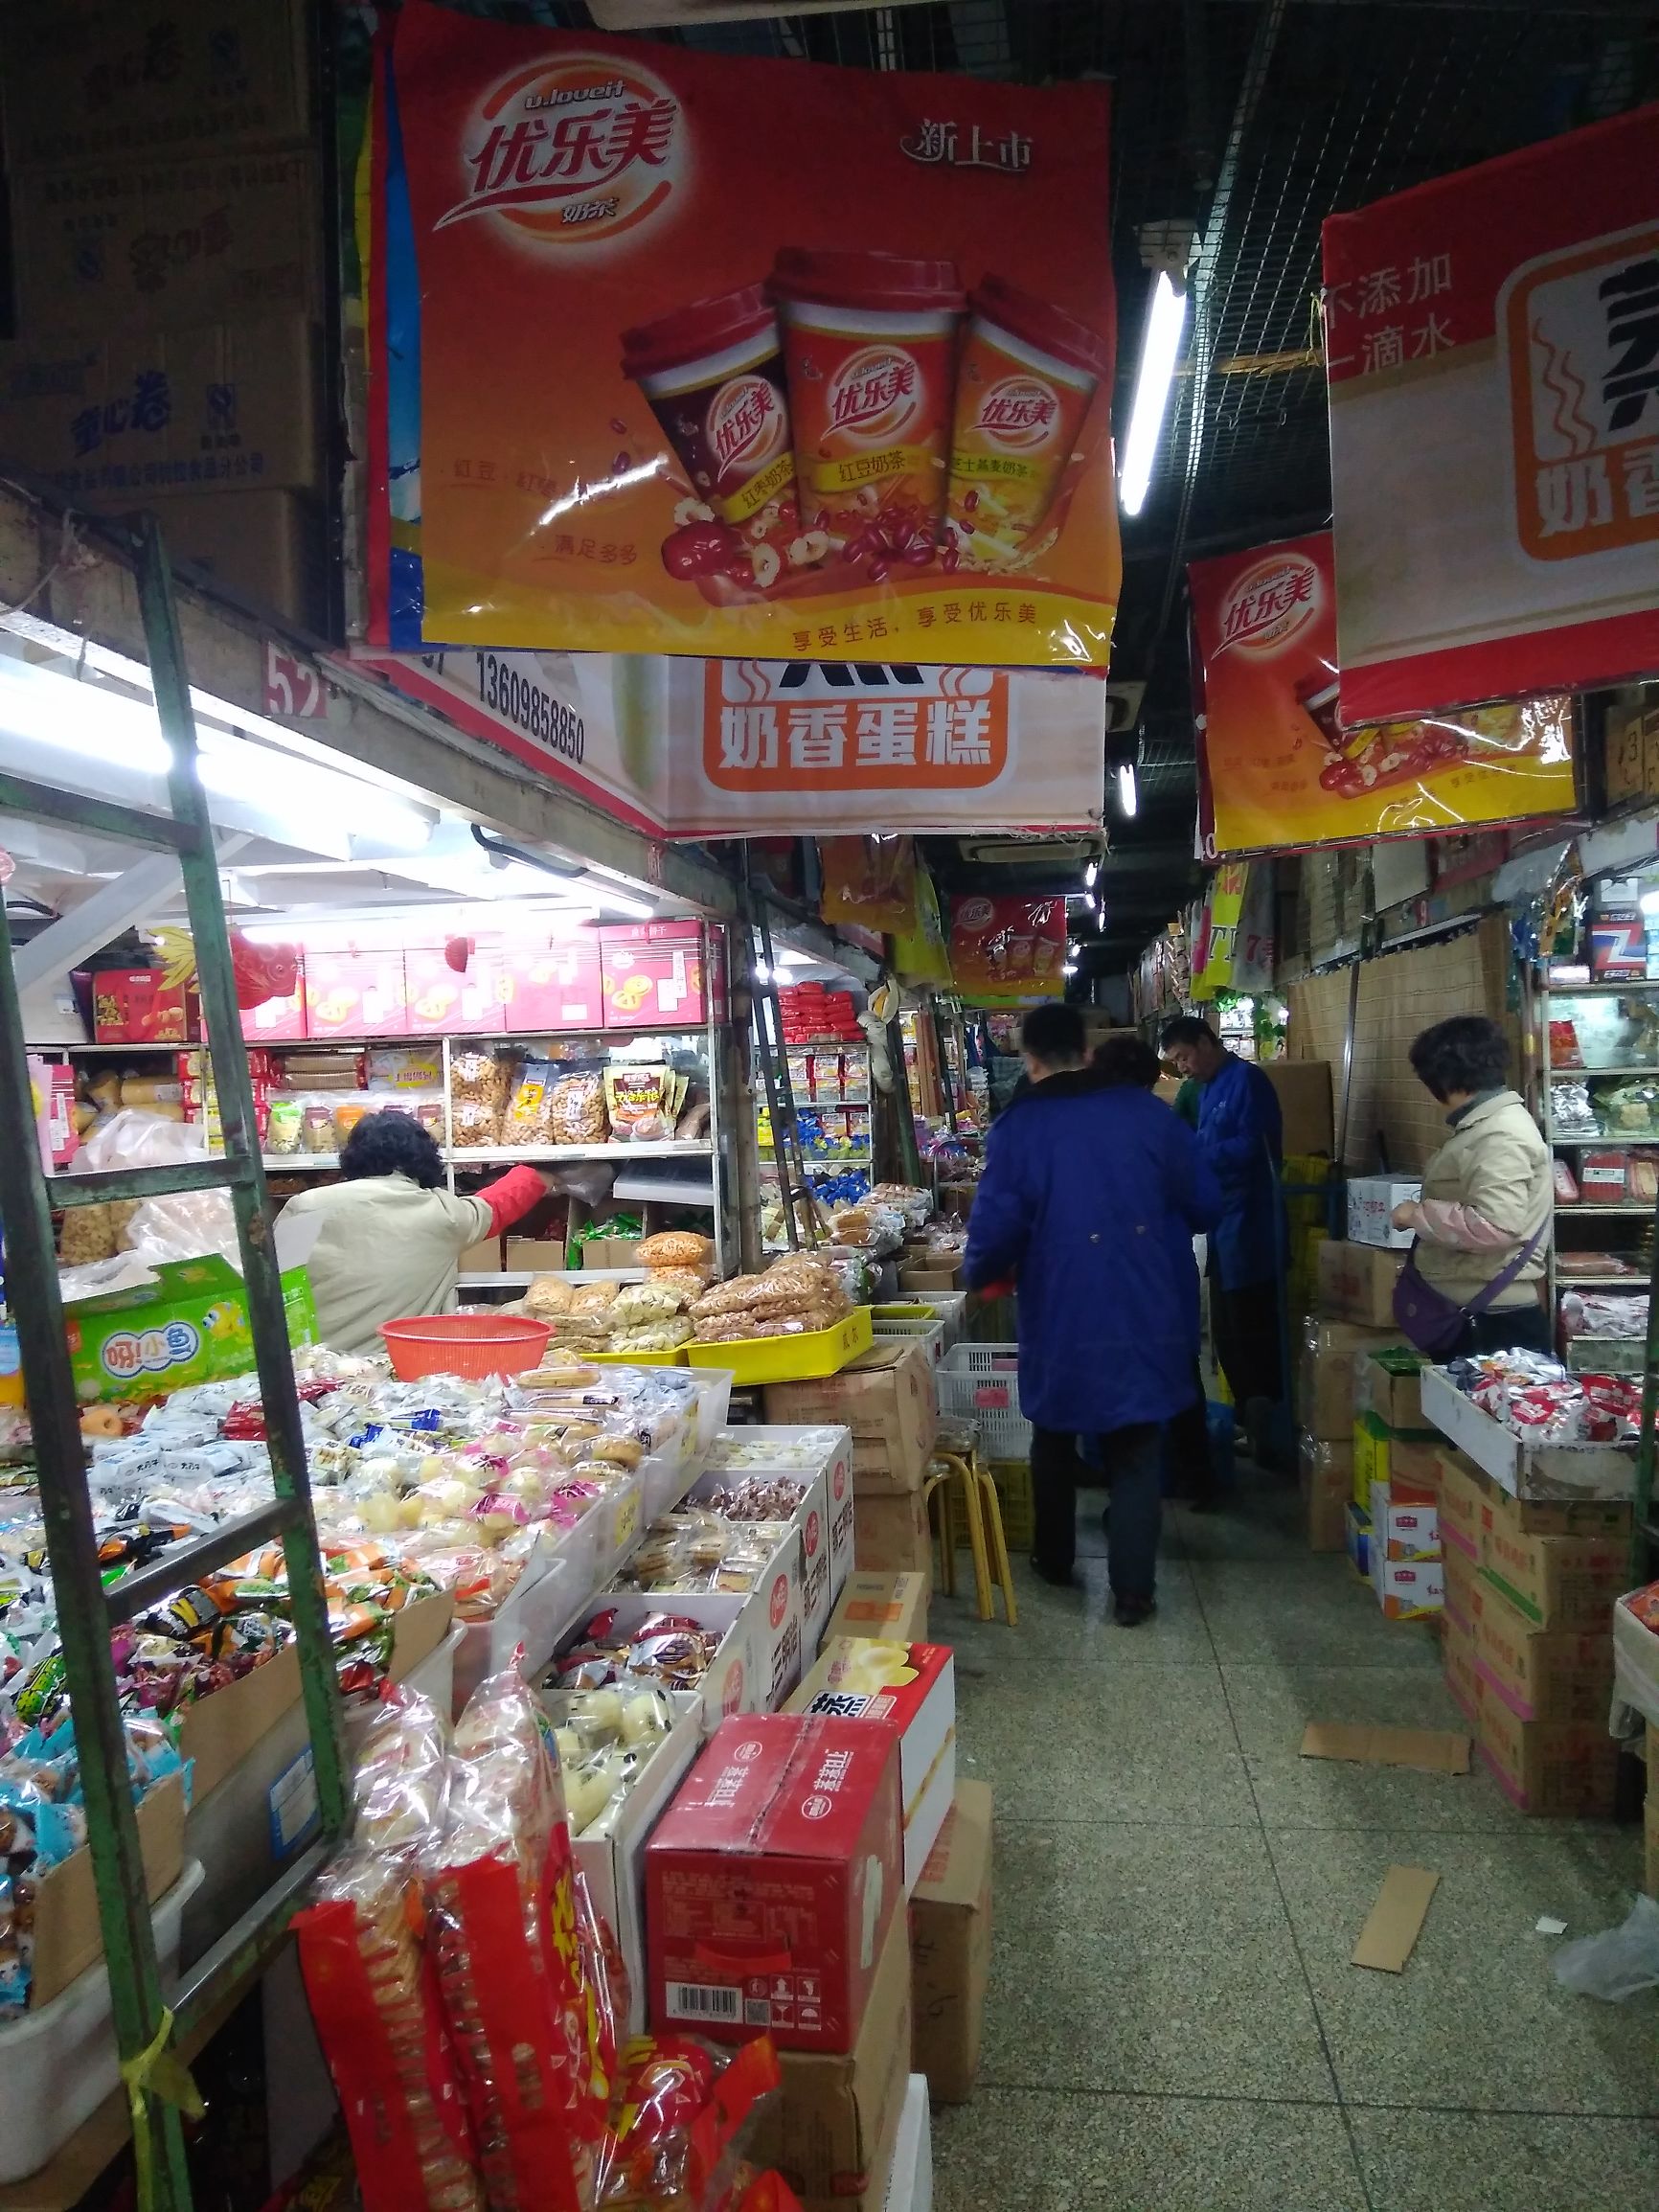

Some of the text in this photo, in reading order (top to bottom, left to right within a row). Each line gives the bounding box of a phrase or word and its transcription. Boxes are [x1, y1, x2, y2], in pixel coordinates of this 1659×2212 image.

[468, 97, 677, 193] 优乐美
[901, 118, 1034, 171] 新上市
[561, 197, 620, 224] 奶茶
[1327, 252, 1454, 331] 不添加
[1329, 311, 1457, 376] 一滴水
[715, 380, 775, 462] 优乐美
[831, 359, 916, 422] 优乐美
[980, 398, 1057, 425] 优乐美
[740, 459, 795, 510] 红枣奶茶
[838, 448, 907, 483] 红豆奶茶
[555, 534, 638, 566] 满足多多
[1223, 566, 1316, 638] 优乐美
[266, 642, 321, 718] 52
[478, 651, 585, 765] 13609858850
[719, 698, 992, 769] 奶香蛋糕
